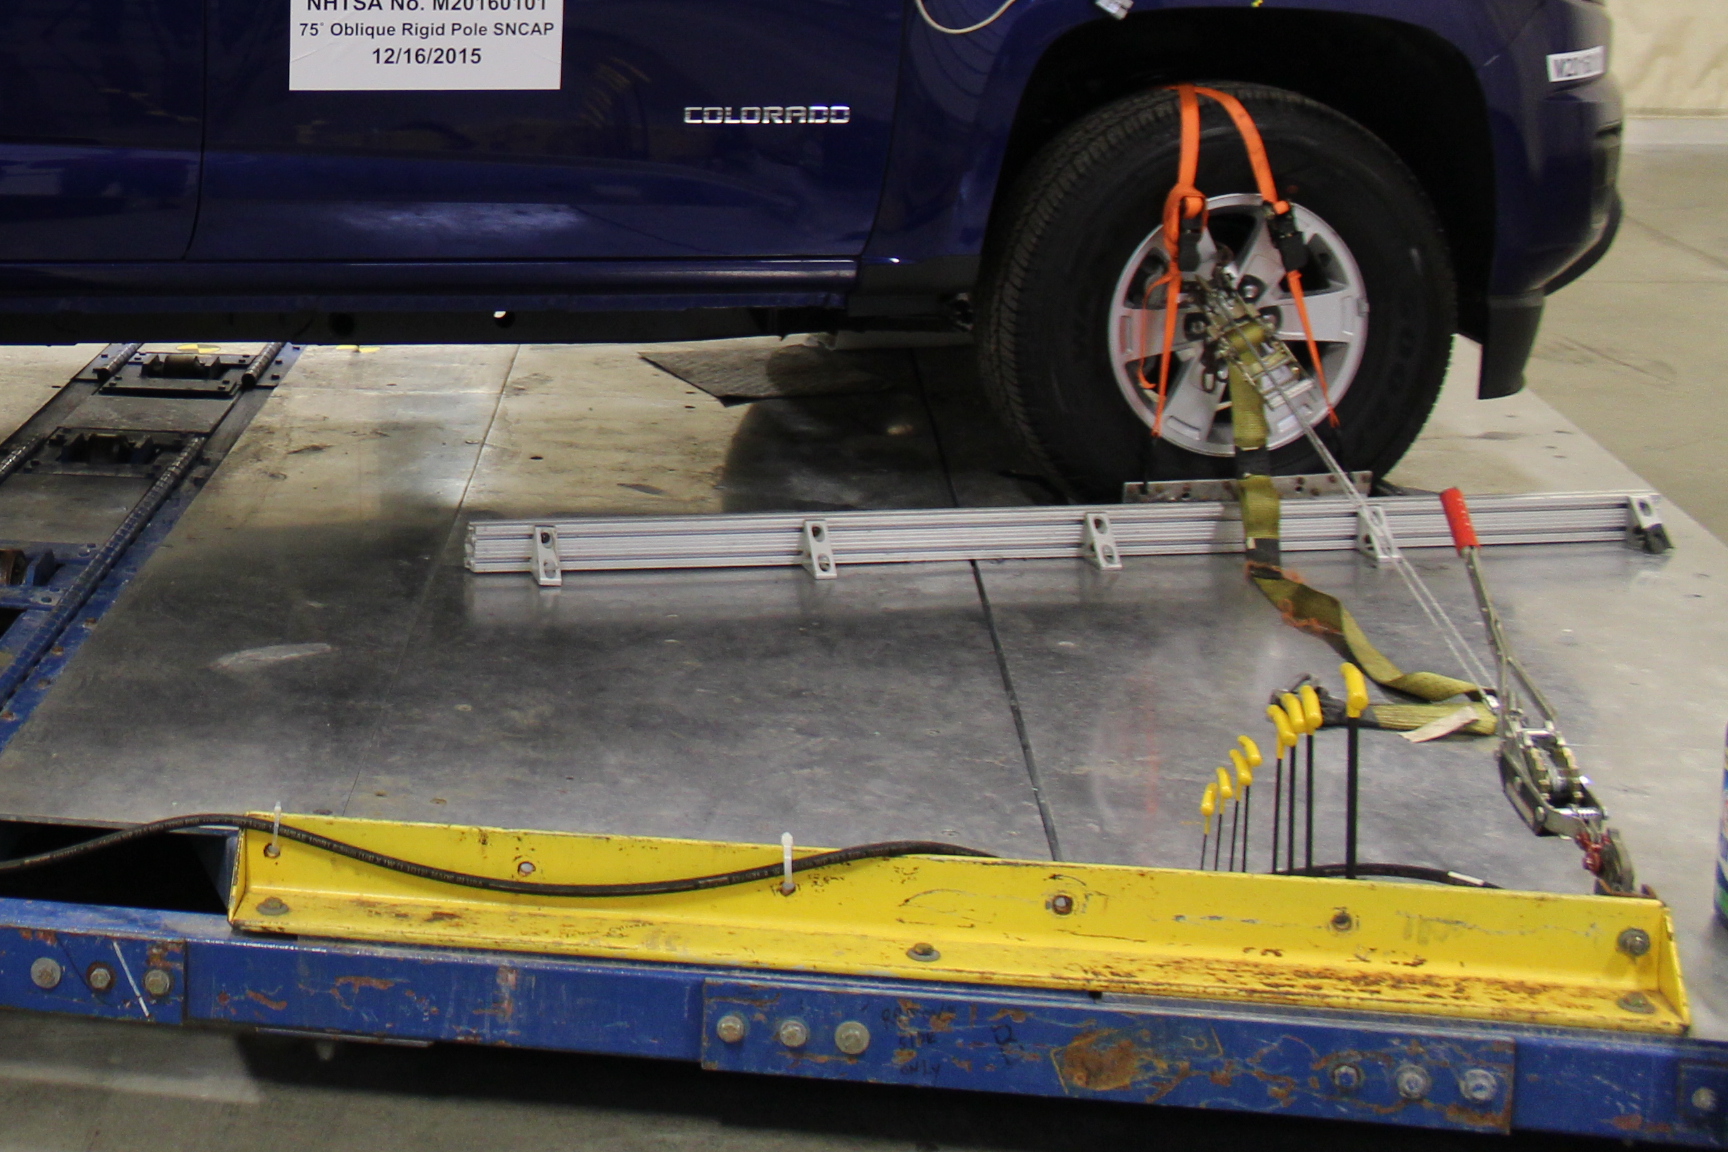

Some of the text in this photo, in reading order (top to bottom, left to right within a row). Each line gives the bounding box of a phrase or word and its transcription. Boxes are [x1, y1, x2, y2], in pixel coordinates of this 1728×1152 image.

[329, 22, 396, 39] Oblique
[401, 22, 446, 39] Rigid
[450, 22, 488, 36] Pole
[492, 22, 555, 37] SNCAP
[371, 47, 482, 65] 12/16/2015
[683, 105, 851, 124] COLORADO
